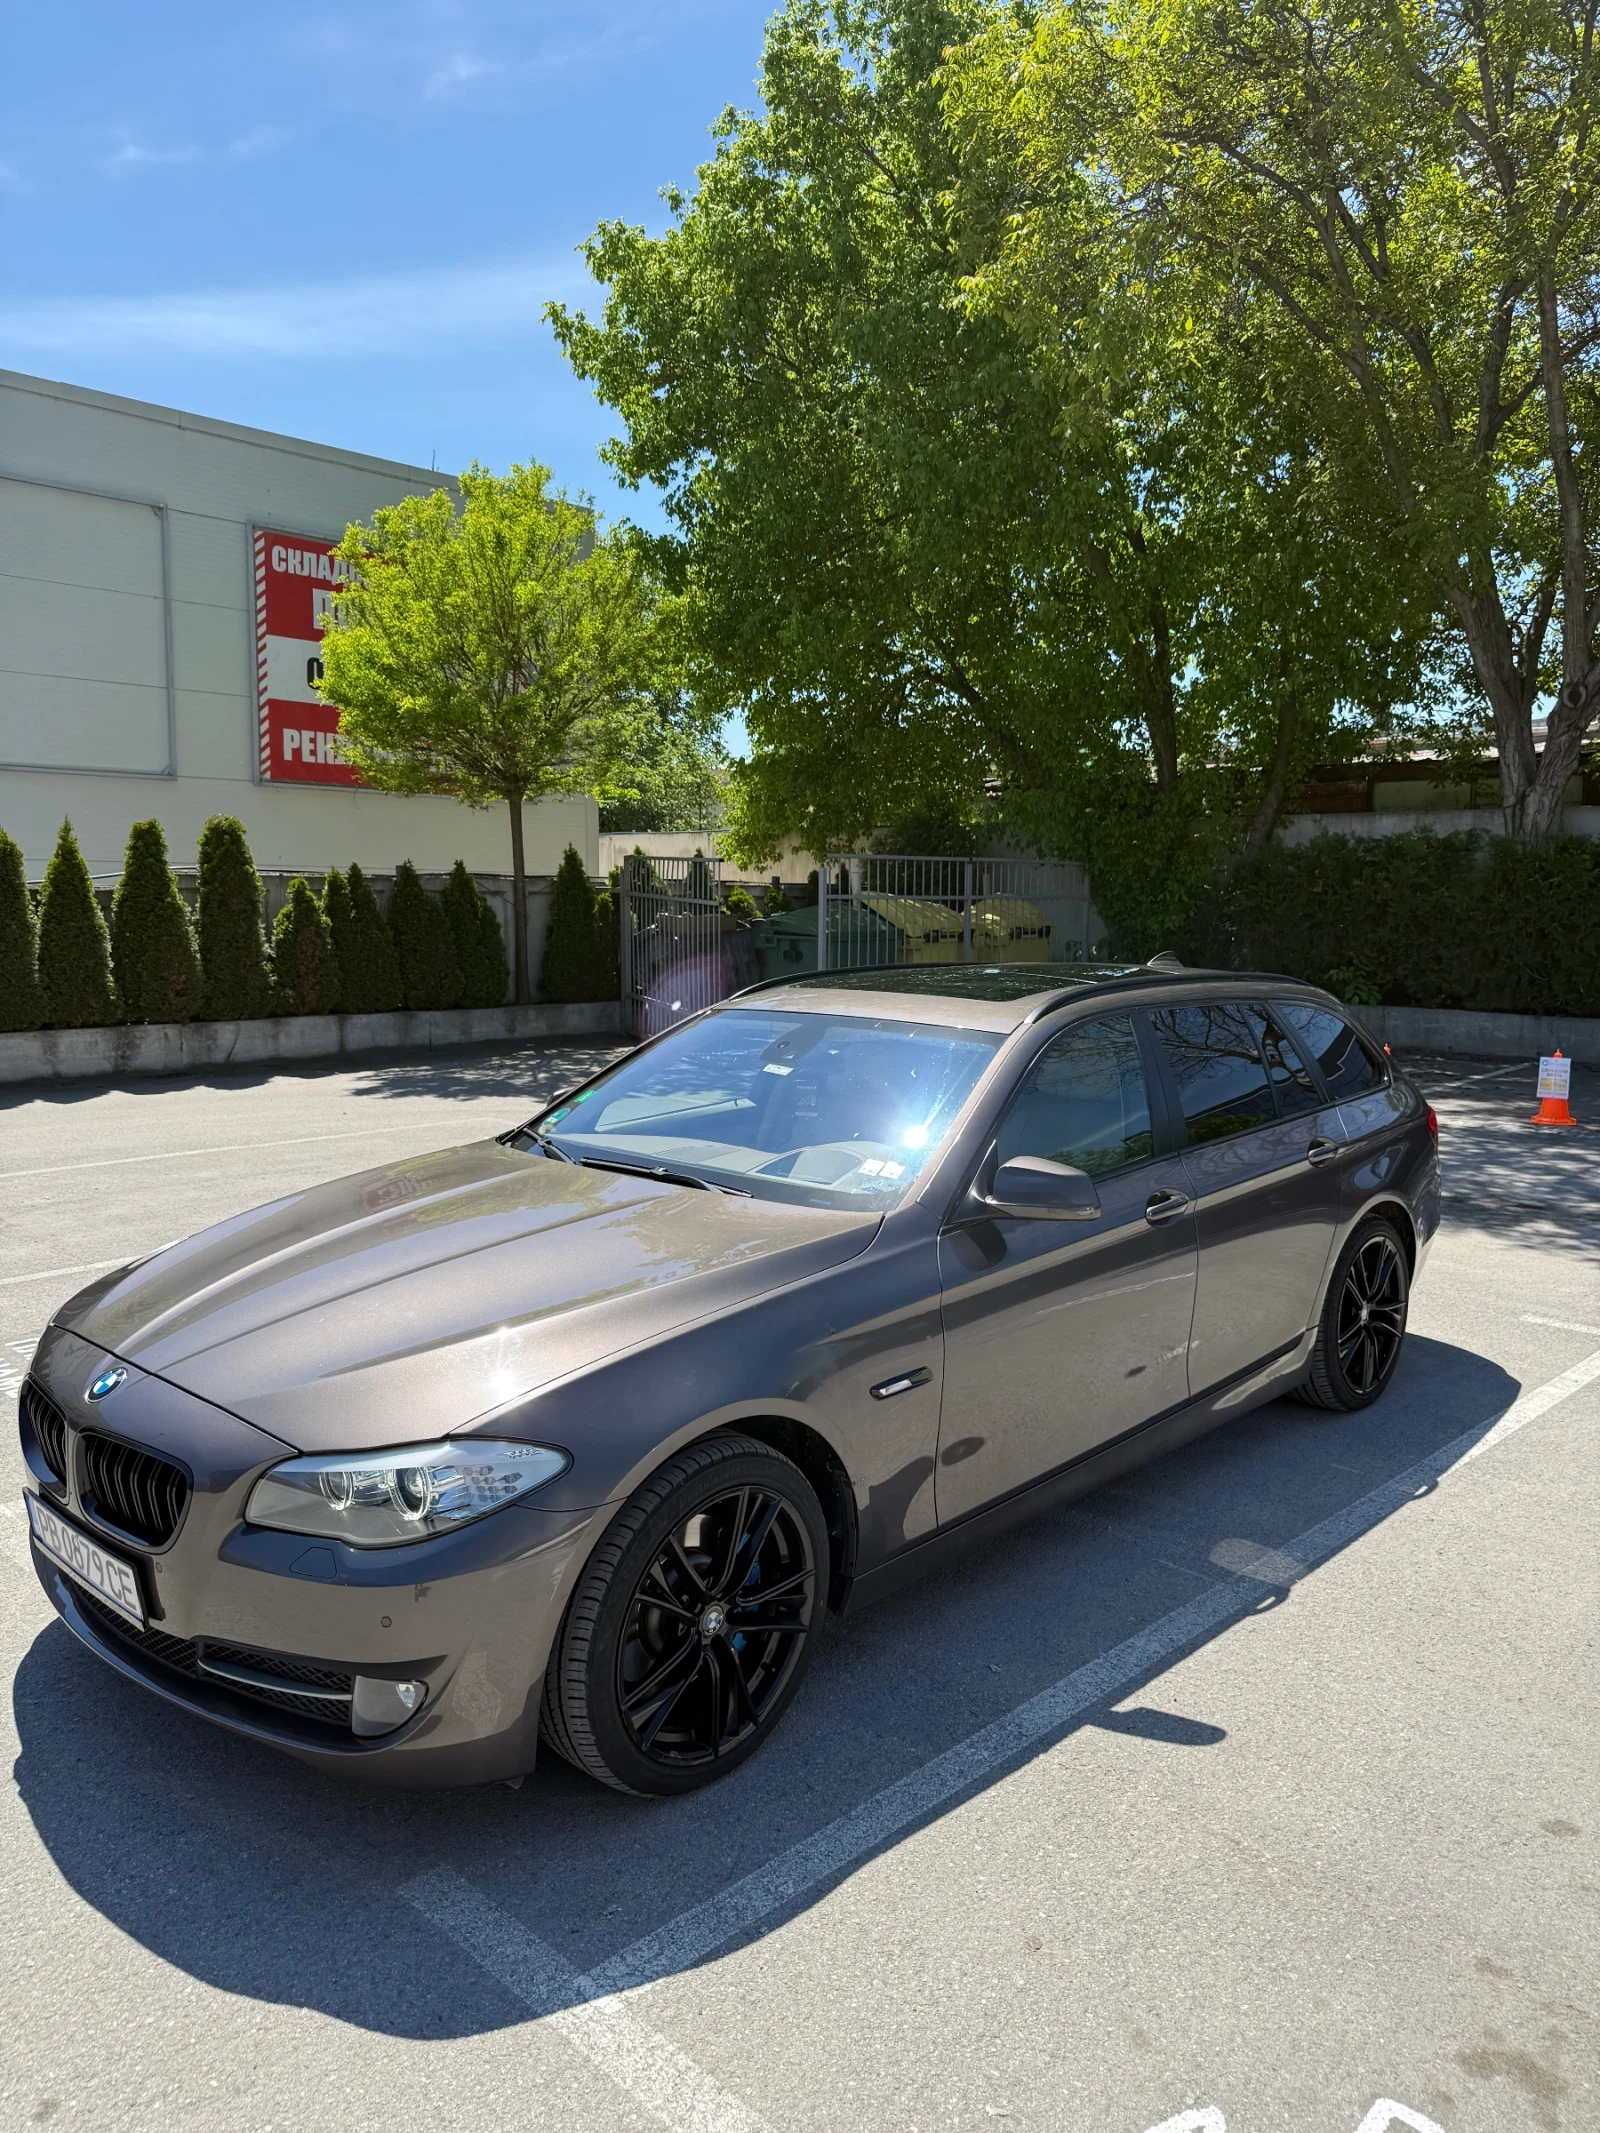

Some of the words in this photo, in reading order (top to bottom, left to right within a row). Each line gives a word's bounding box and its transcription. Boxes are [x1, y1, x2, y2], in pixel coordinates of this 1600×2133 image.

[36, 1504, 62, 1552] PB
[61, 1525, 105, 1588] 0879
[105, 1559, 138, 1612] CE
